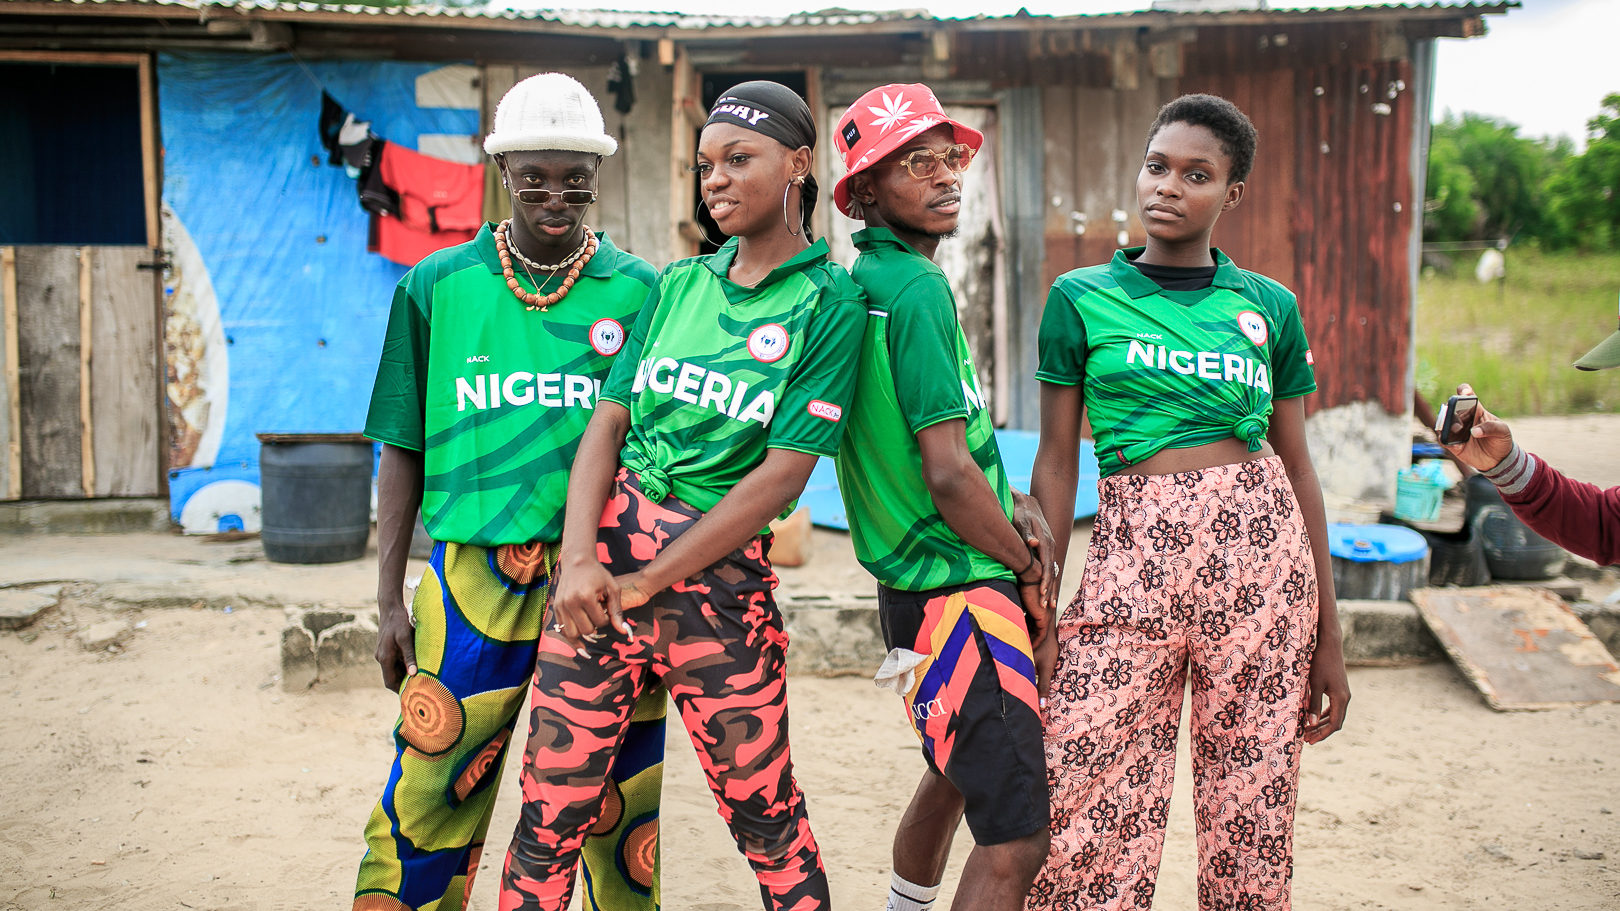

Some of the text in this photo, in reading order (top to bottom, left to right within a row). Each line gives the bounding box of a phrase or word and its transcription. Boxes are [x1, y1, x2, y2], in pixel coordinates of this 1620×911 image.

[1136, 332, 1163, 340] NACK
[1126, 340, 1271, 394] NIGERIA
[811, 404, 834, 417] NACK
